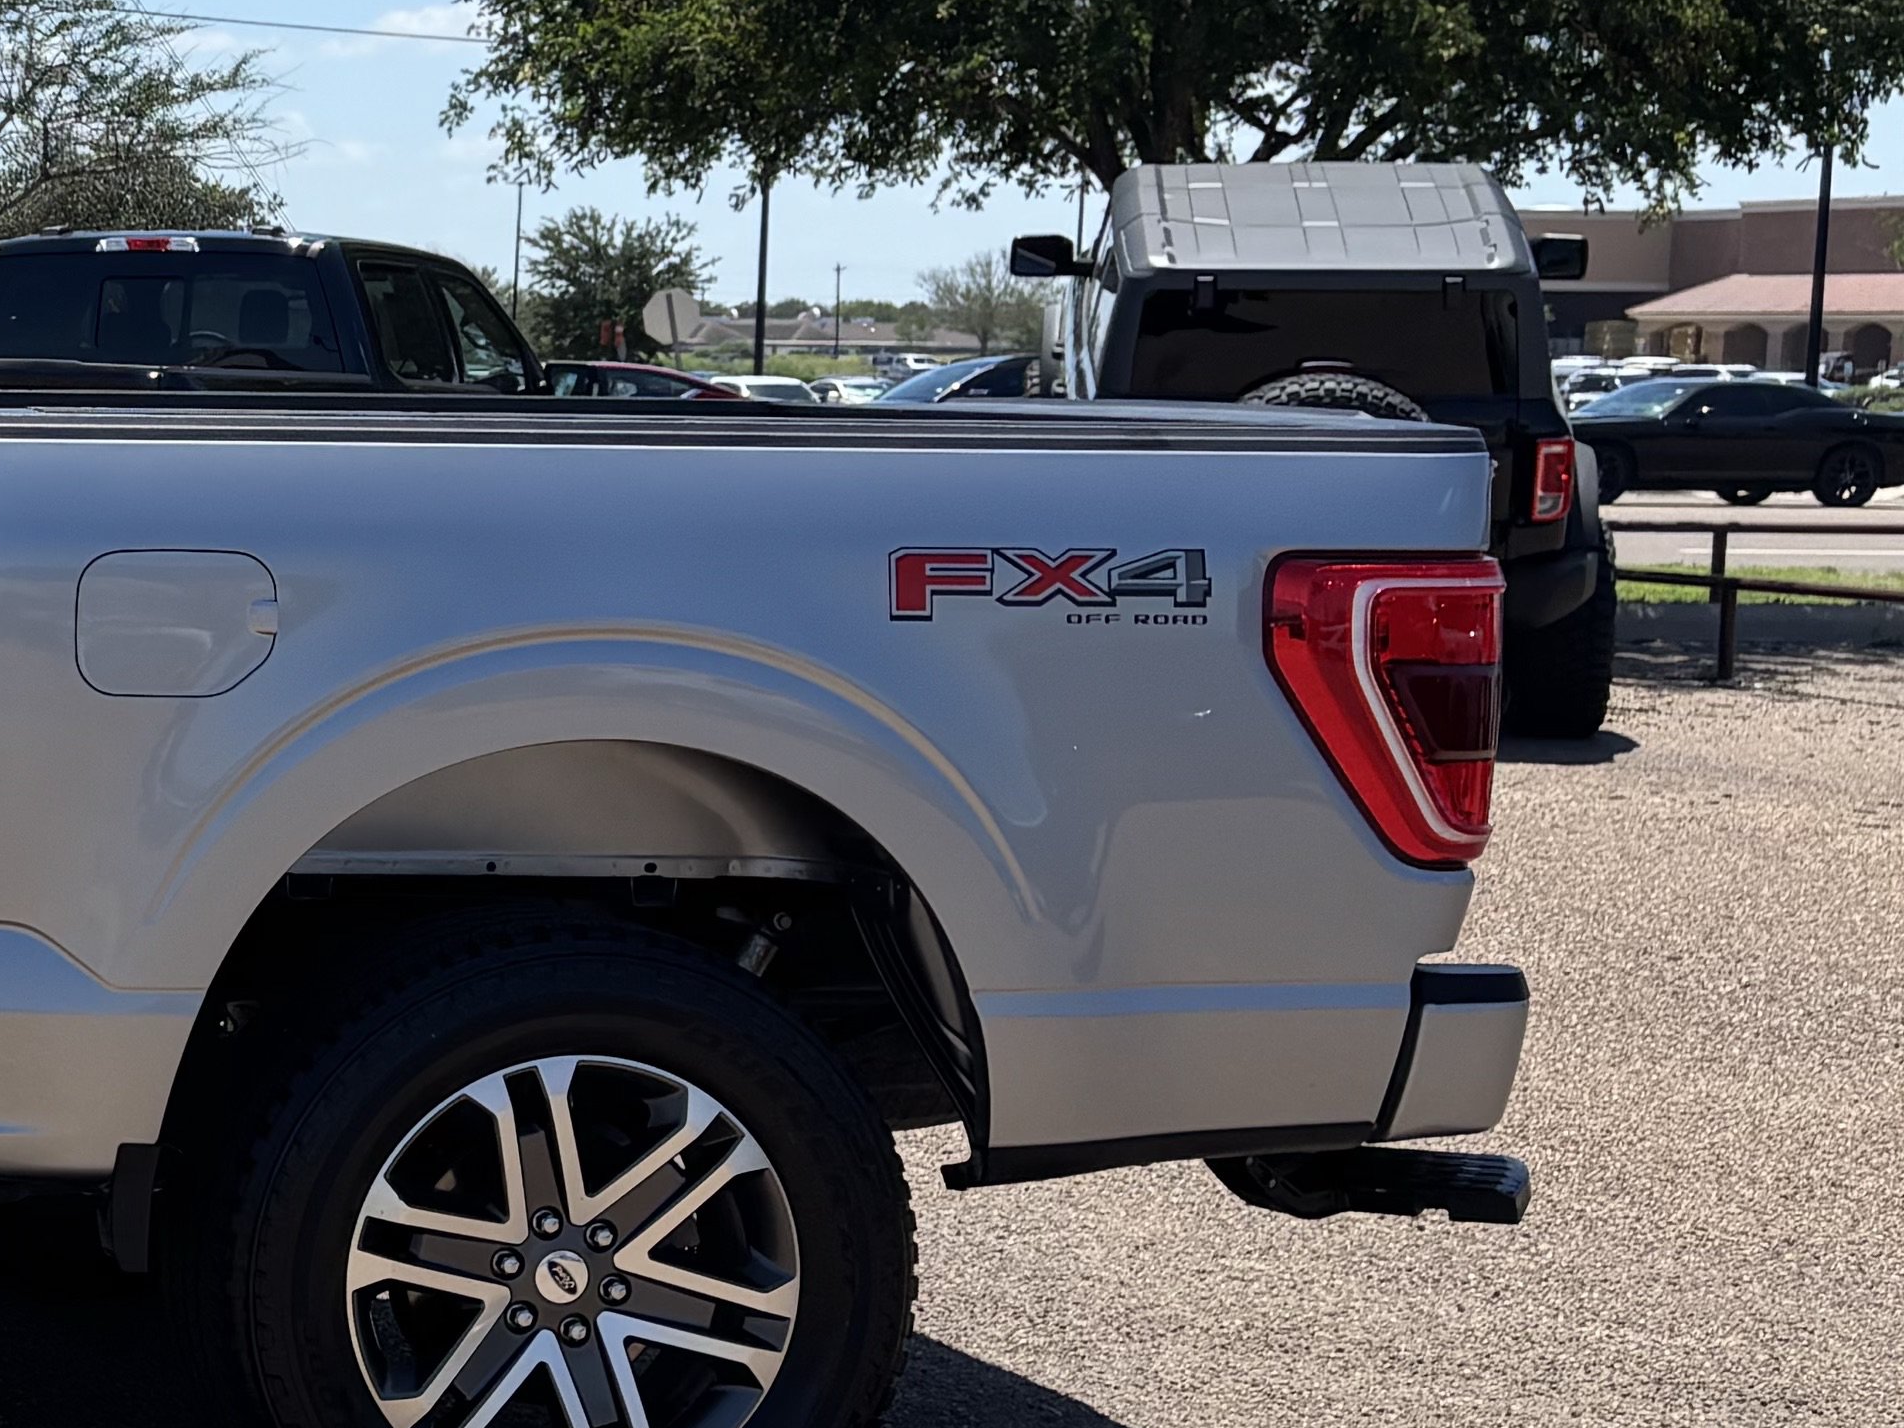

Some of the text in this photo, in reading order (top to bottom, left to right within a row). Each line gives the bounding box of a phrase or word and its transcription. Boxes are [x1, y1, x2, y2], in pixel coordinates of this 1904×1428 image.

[887, 546, 1213, 622] FX4
[1065, 613, 1209, 626] OFF ROAD
